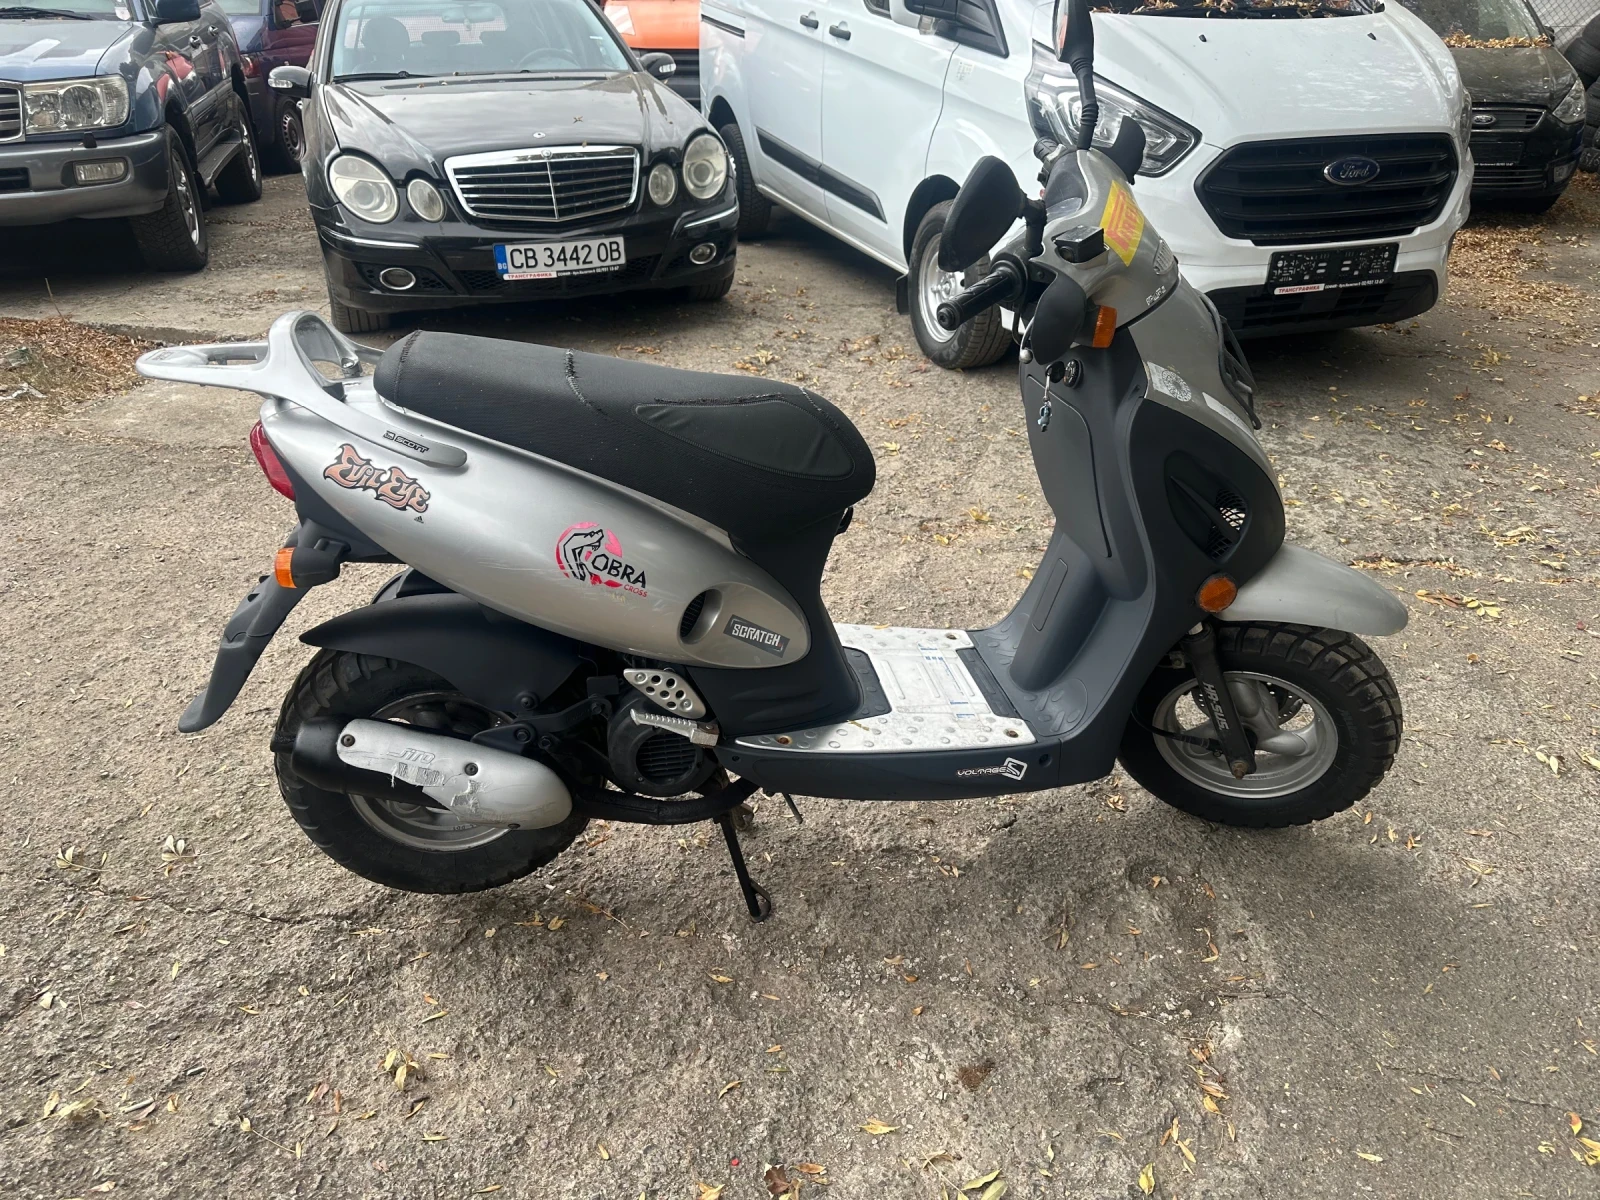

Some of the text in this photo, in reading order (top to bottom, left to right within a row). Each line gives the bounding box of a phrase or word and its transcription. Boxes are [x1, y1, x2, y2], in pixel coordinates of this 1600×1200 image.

[1340, 162, 1370, 178] Ford
[509, 241, 622, 269] CB 3442 OB
[497, 262, 507, 270] BG
[507, 272, 553, 280] ТРАНСГРАФИКА
[1278, 285, 1320, 294] ТРАНСГРАФИКА
[395, 435, 430, 454] SCOTT
[623, 584, 648, 598] CROSS
[731, 623, 781, 647] SCRATCH
[957, 766, 1007, 776] VOLTAGE
